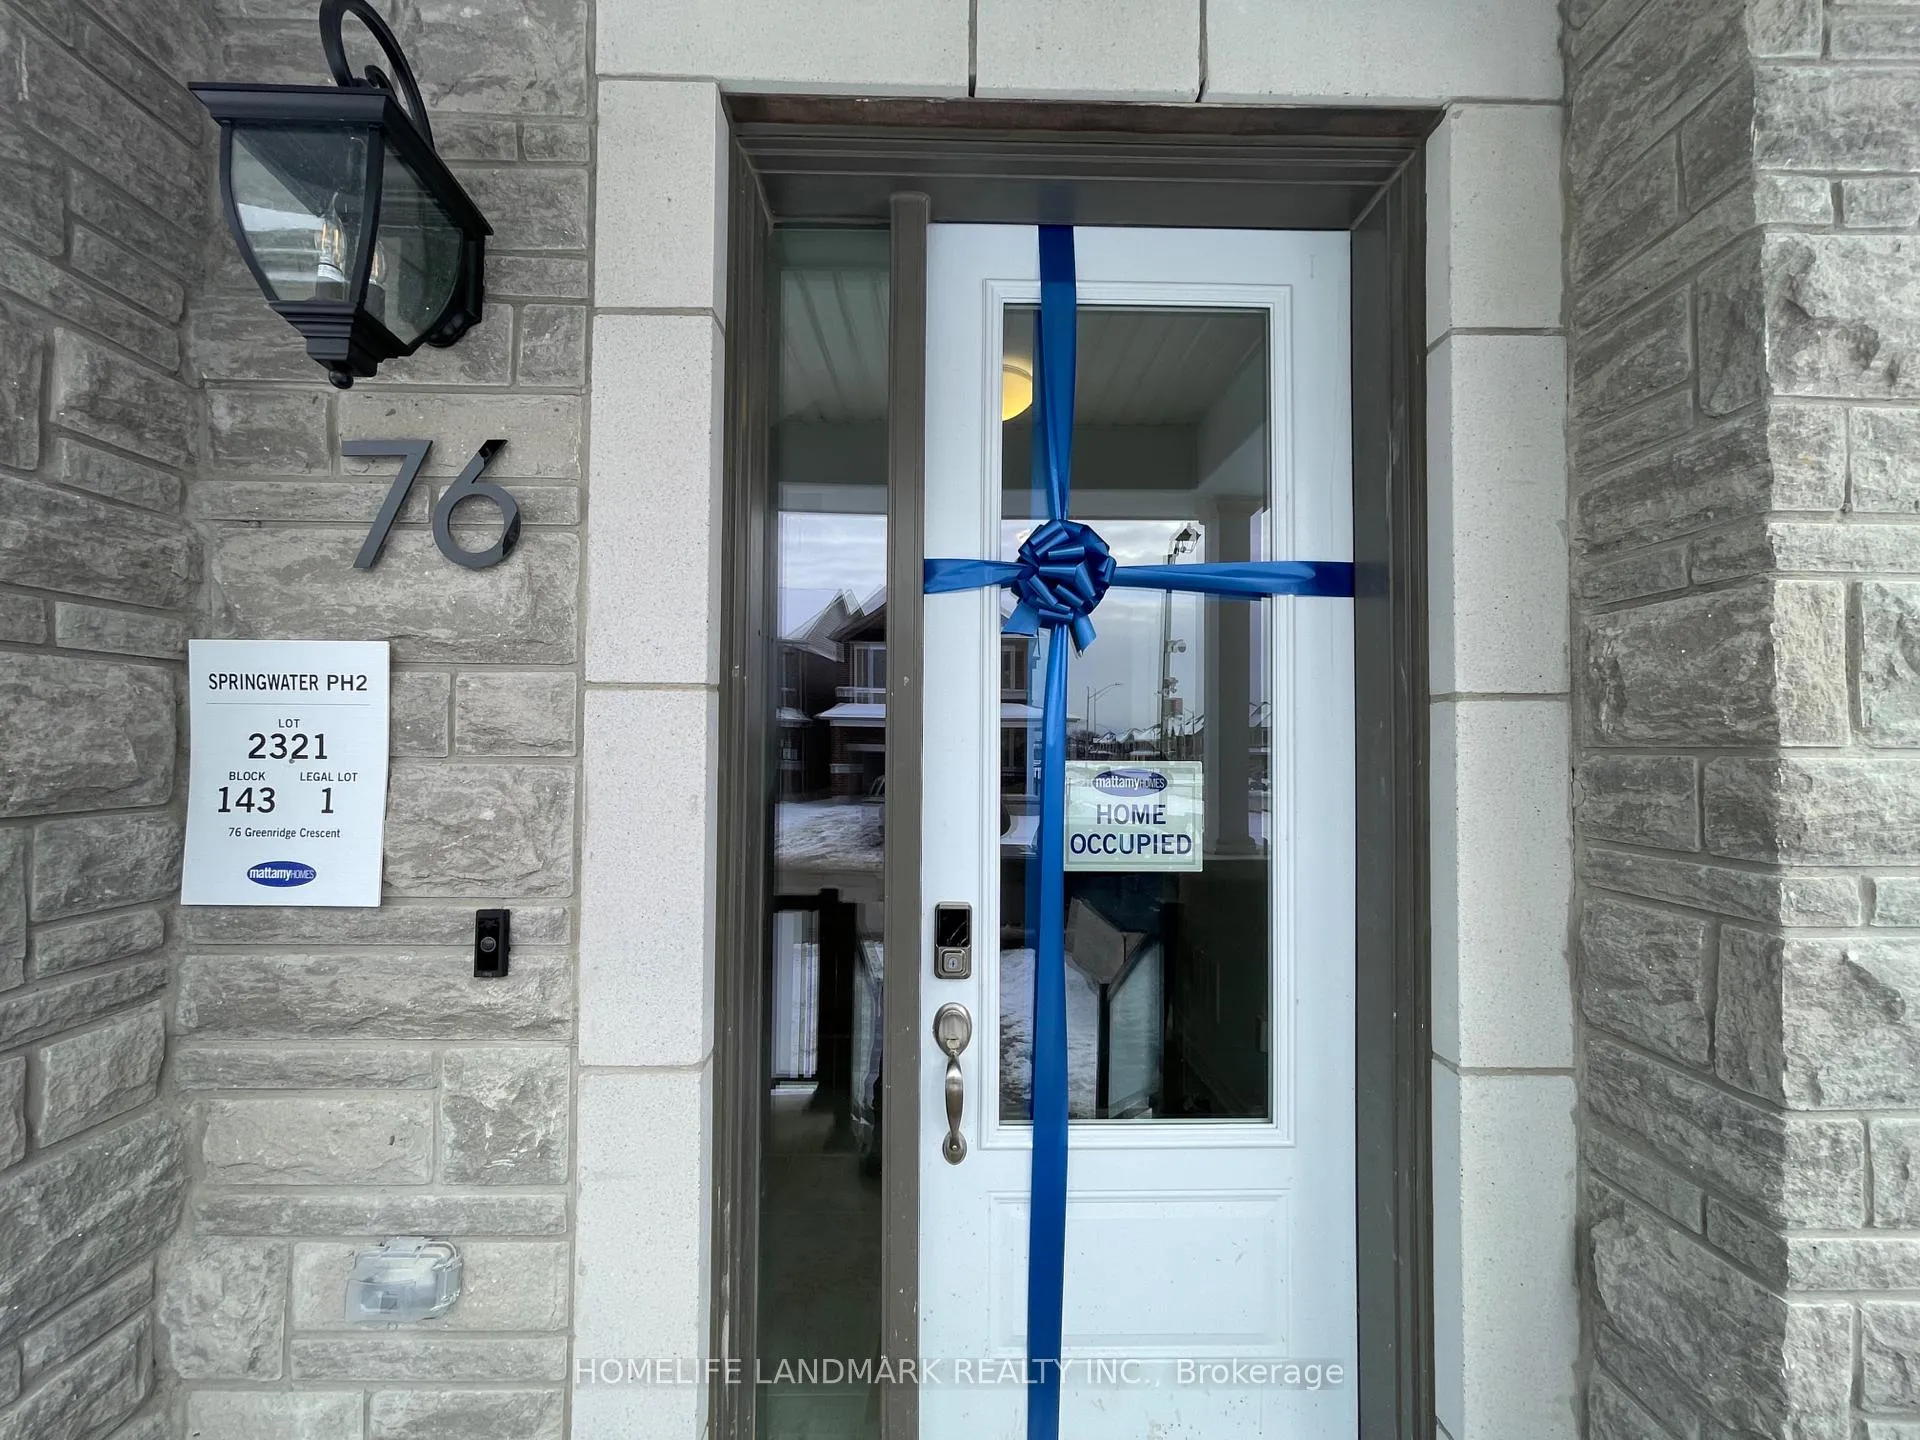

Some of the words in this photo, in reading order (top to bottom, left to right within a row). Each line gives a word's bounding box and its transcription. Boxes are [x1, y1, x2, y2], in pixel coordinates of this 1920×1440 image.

[341, 439, 521, 569] 76
[208, 672, 319, 691] SPRINGWATER
[327, 674, 368, 691] PH2
[278, 718, 301, 729] LOT
[248, 732, 328, 760] 2321
[229, 771, 266, 781] BLOCK
[300, 772, 334, 782] LEGAL
[338, 772, 358, 782] LOT
[217, 786, 276, 813] 143
[321, 787, 334, 814] 1
[1096, 804, 1166, 825] HOME
[228, 827, 242, 837] 76
[244, 827, 296, 840] Greenridge
[300, 828, 341, 838] Crescent
[1070, 833, 1192, 855] OCCUPIED
